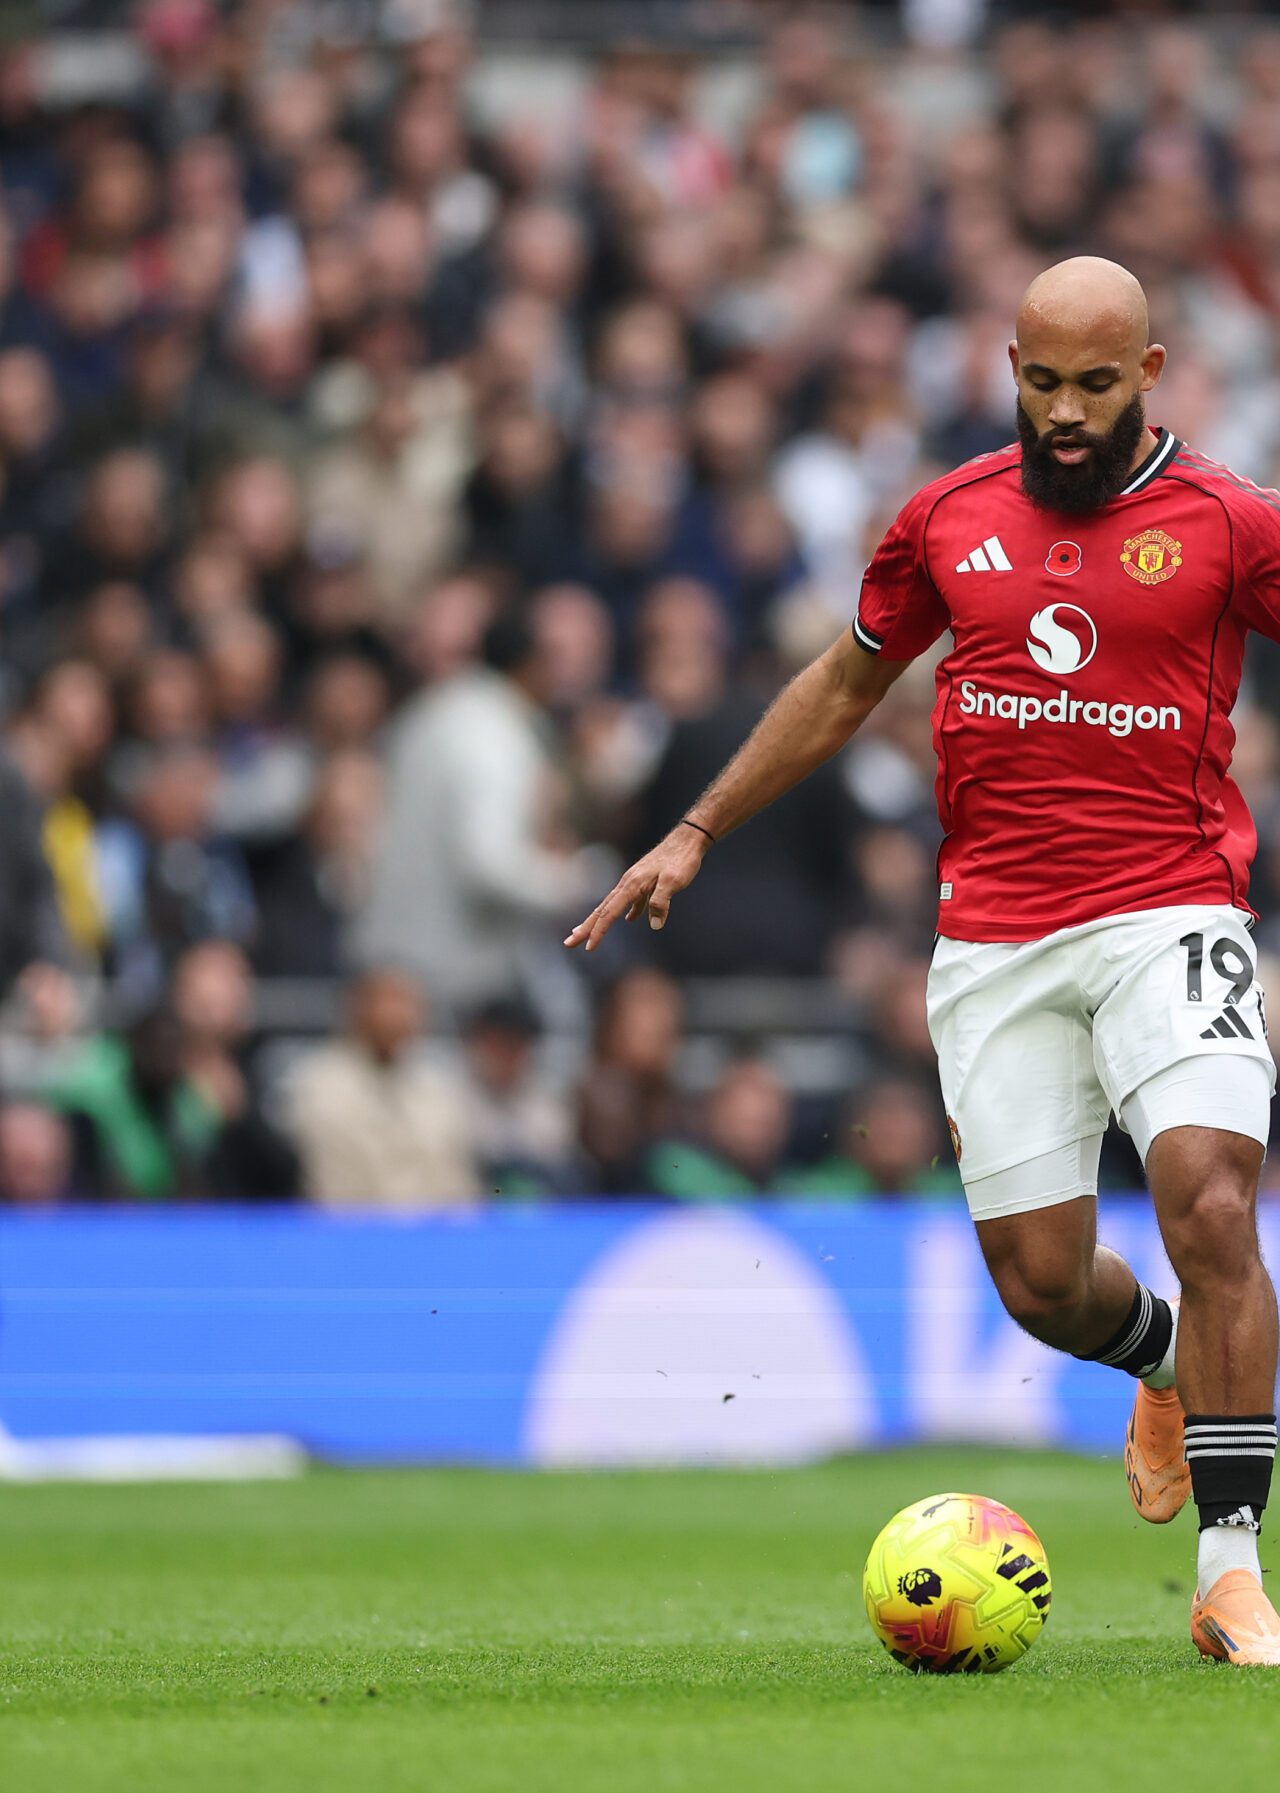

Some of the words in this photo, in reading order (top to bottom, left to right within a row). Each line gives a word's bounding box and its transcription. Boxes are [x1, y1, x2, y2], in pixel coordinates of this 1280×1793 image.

[1128, 533, 1178, 553] MANCHESTER
[1132, 570, 1167, 581] UNITED
[959, 680, 1181, 737] Snapdragon
[1179, 932, 1254, 1005] 19
